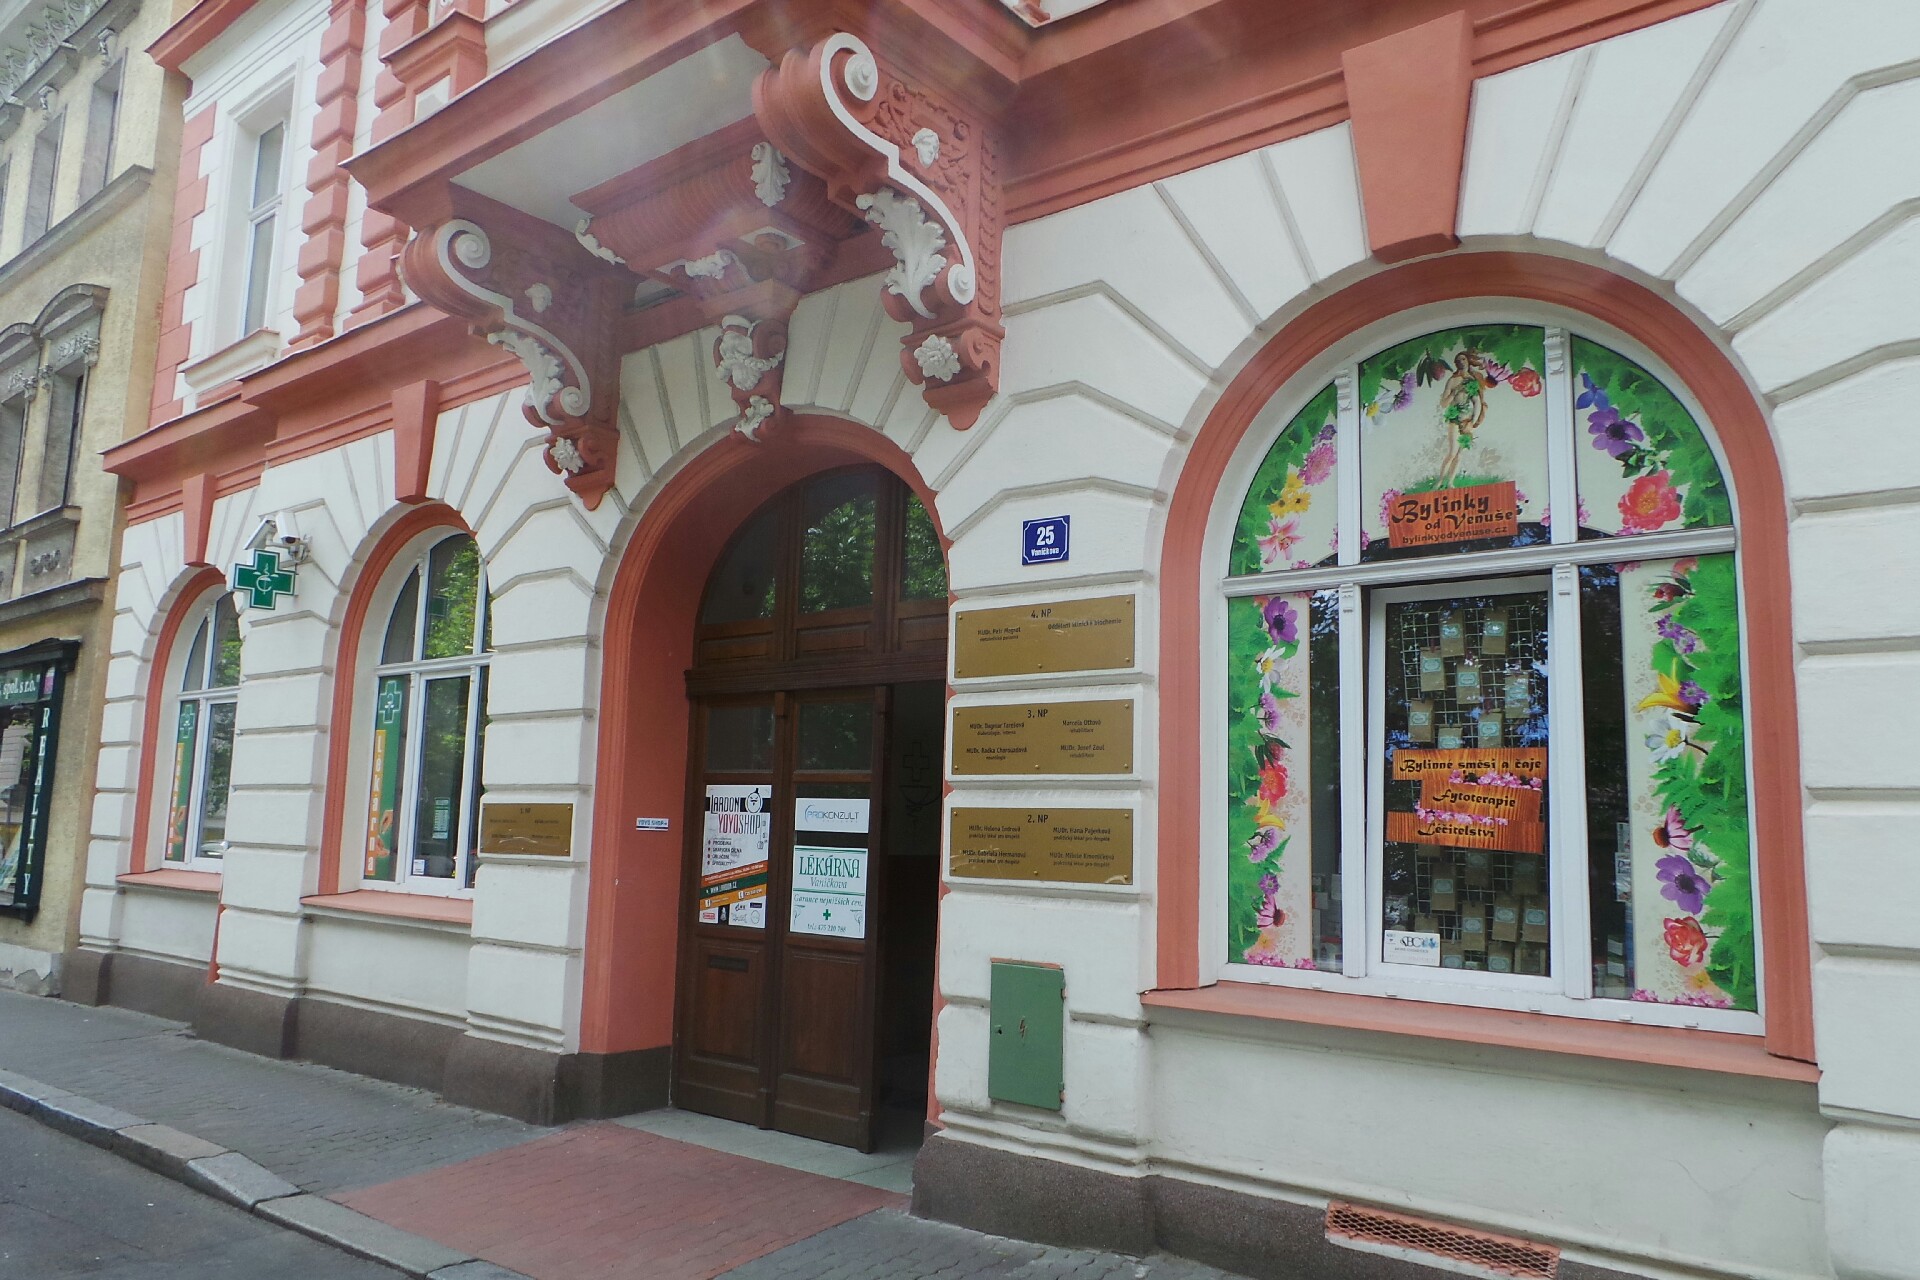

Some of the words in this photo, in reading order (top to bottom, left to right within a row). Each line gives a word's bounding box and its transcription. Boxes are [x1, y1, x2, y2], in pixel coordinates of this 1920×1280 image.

[1391, 493, 1489, 523] Bylinky
[1425, 519, 1441, 530] od
[1444, 509, 1514, 530] Venuše
[1036, 525, 1055, 546] 25
[1402, 526, 1508, 544] bylinkyodvenuse.cz
[1041, 608, 1052, 617] NP
[1027, 709, 1035, 718] 3.
[1037, 708, 1049, 718] NP
[1399, 759, 1453, 773] Bylinné
[1458, 758, 1496, 769] směsi
[1502, 761, 1509, 769] a
[1514, 758, 1541, 772] čaje
[23, 707, 51, 896] REALITY
[1027, 814, 1035, 823] 2.
[1037, 814, 1049, 824] NP
[799, 854, 860, 879] LÉKÁRNA
